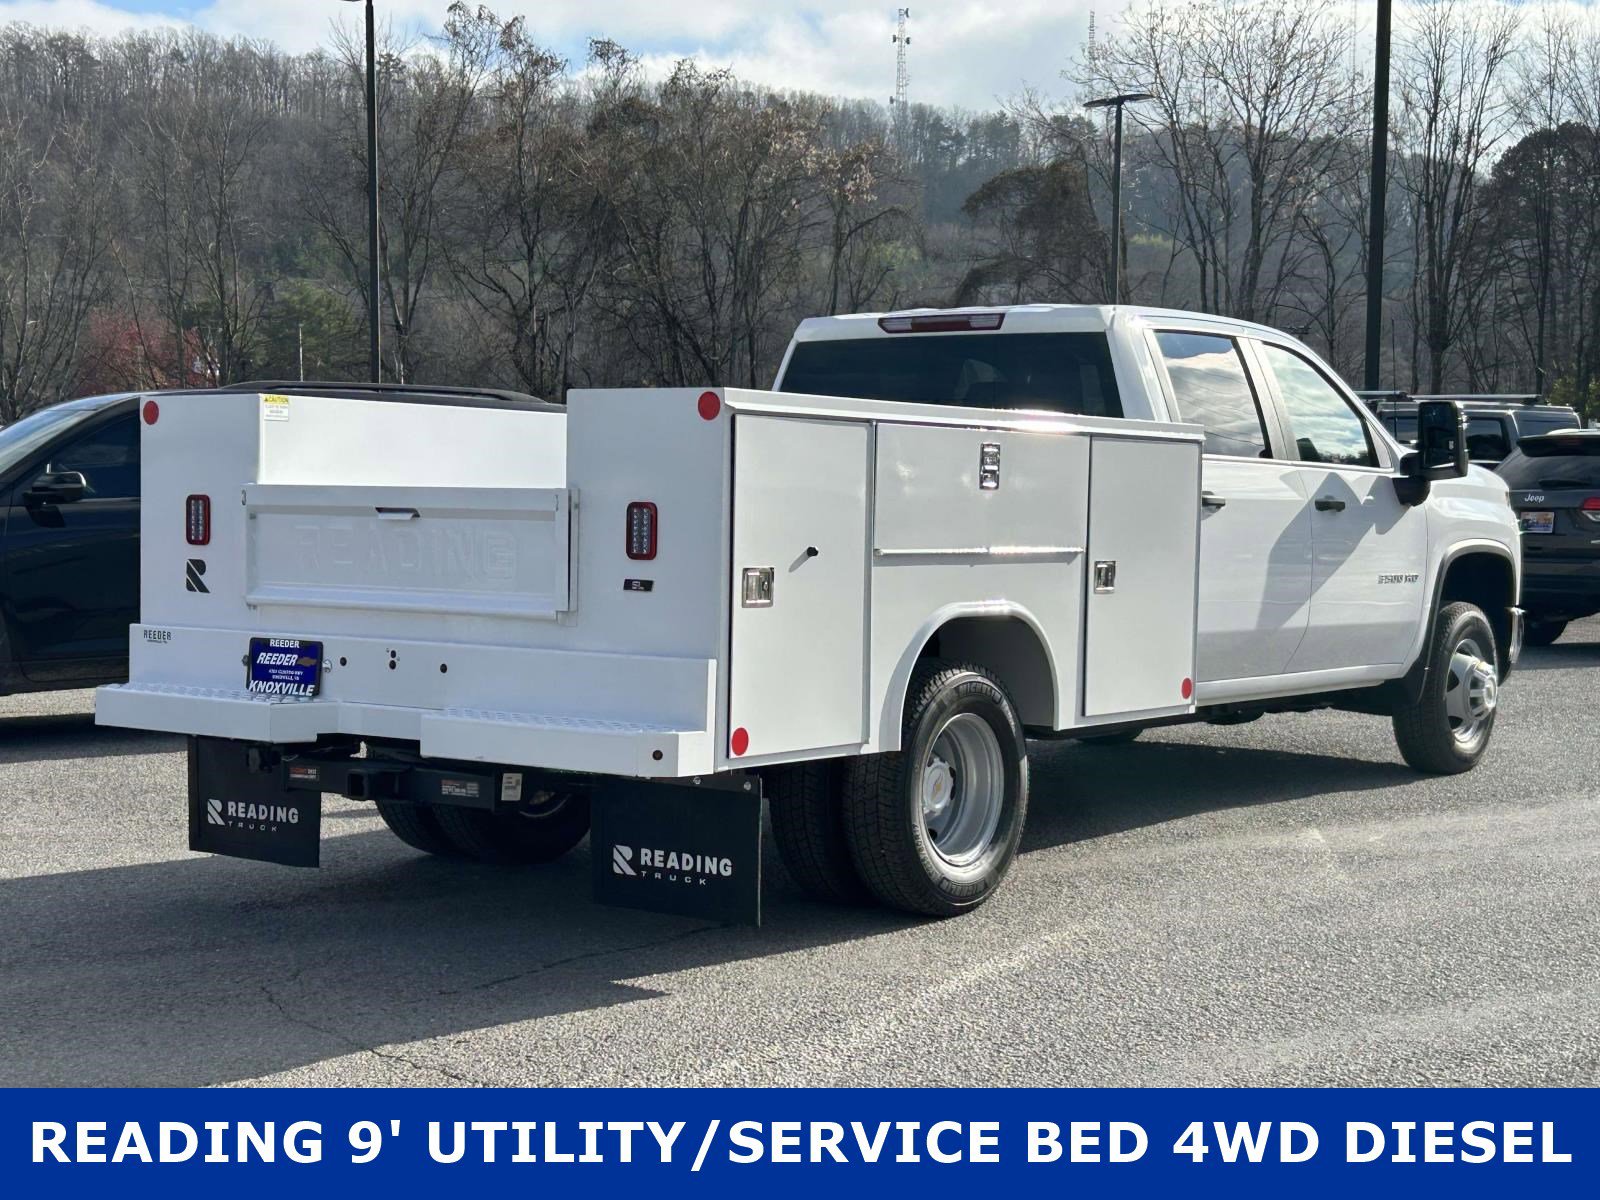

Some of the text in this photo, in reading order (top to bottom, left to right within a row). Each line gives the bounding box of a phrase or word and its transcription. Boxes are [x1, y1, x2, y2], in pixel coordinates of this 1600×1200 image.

[1524, 493, 1545, 503] Jeep
[293, 522, 519, 581] READING
[143, 629, 172, 641] REEDER
[270, 639, 300, 648] REEDER
[256, 652, 298, 666] REEDER
[249, 680, 315, 696] KNOXVILLE
[227, 800, 299, 824] READING
[227, 820, 278, 832] TRUCK
[640, 847, 733, 877] READING
[641, 870, 707, 886] TRUCK
